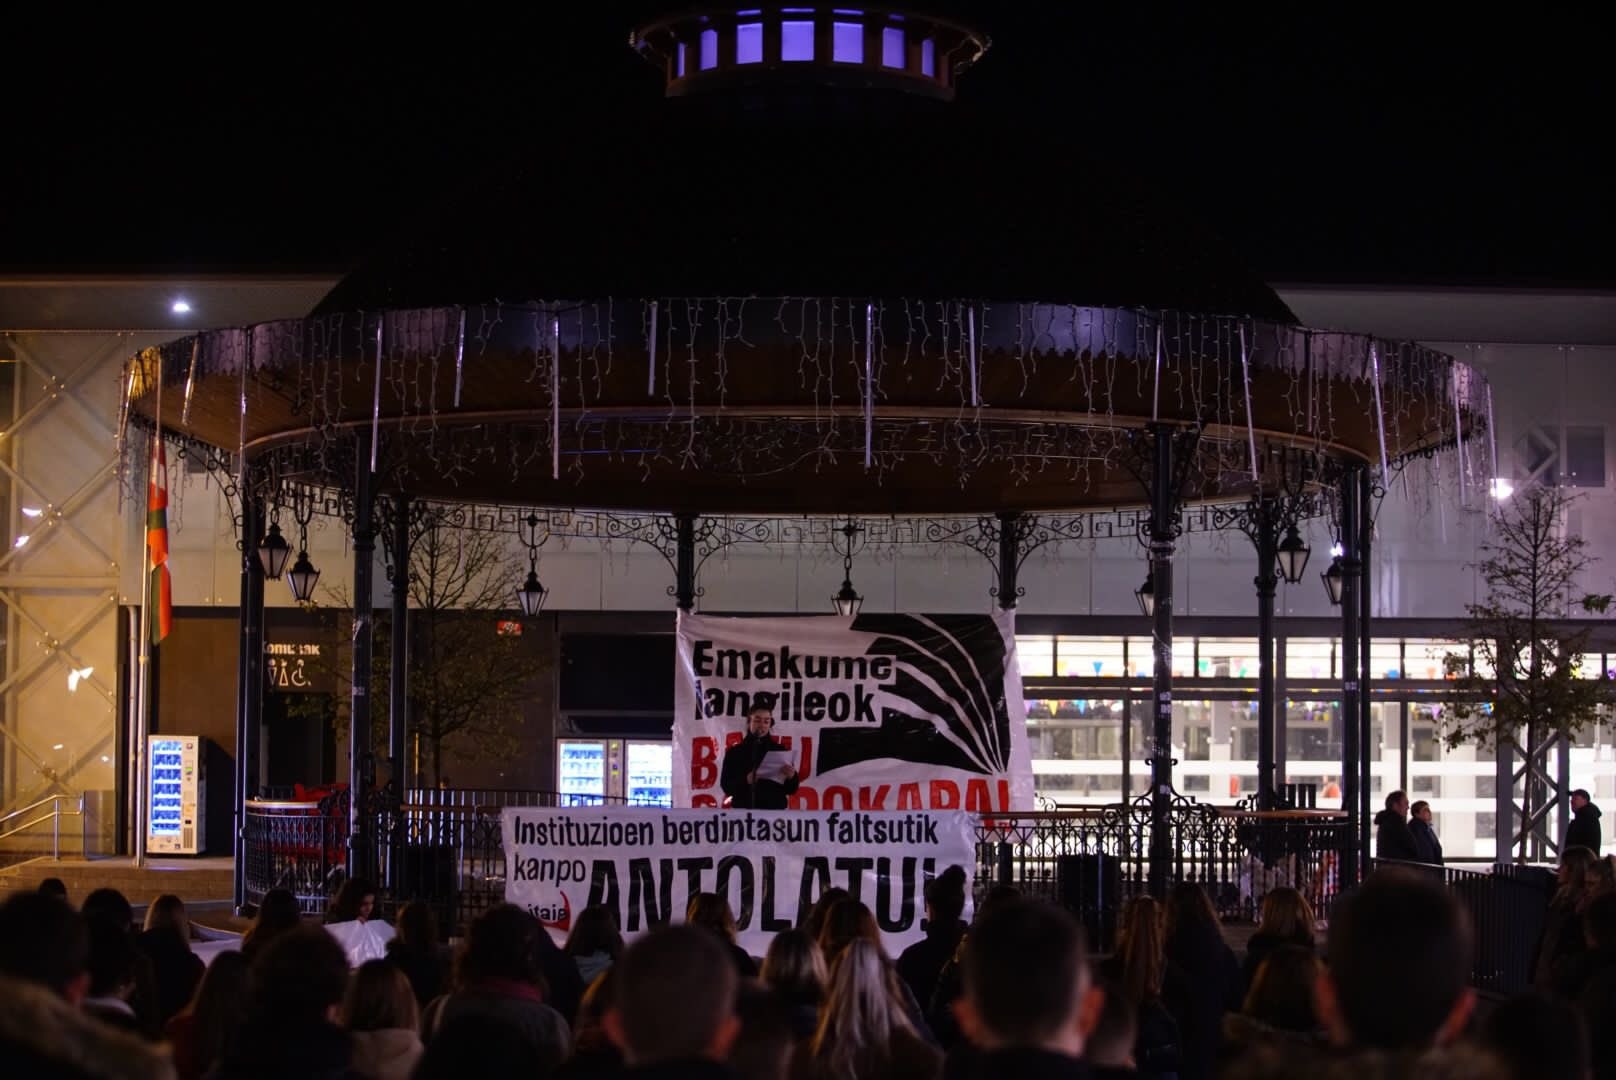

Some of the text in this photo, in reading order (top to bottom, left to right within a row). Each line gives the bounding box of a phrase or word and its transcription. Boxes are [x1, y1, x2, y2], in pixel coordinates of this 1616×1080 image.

[693, 640, 893, 680] Emakume
[515, 813, 938, 846] Instituzioen berdintasun faltsutik
[514, 852, 585, 887] kanpo
